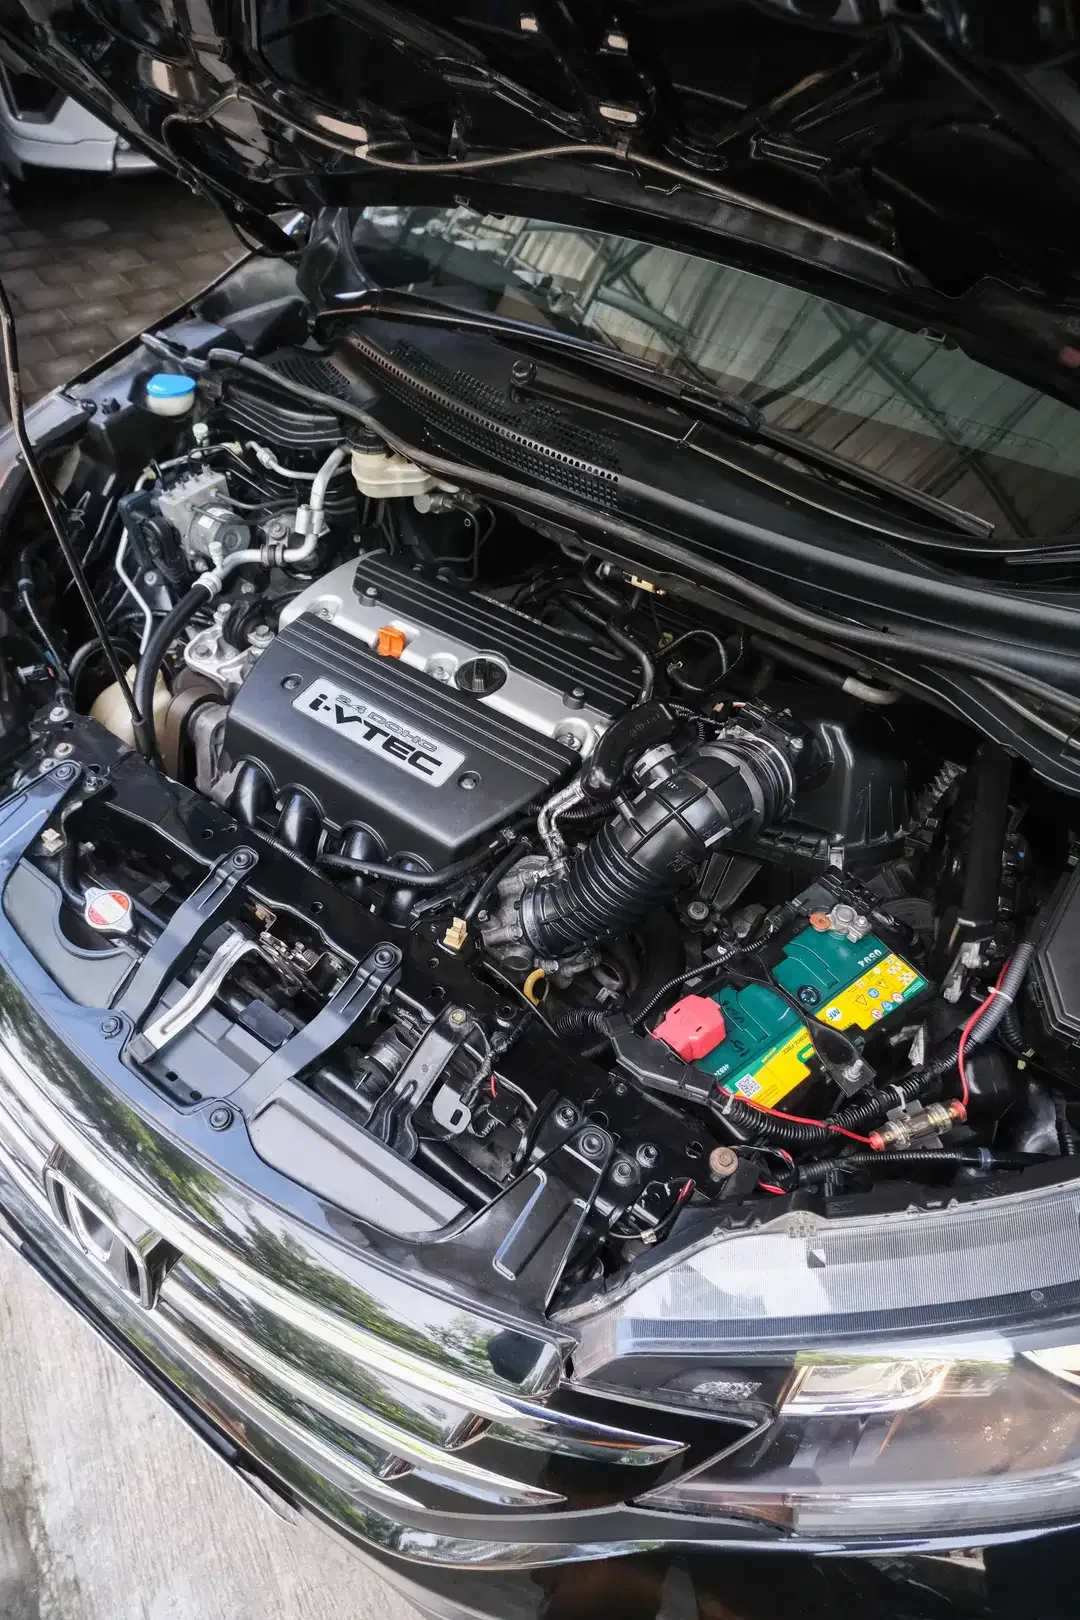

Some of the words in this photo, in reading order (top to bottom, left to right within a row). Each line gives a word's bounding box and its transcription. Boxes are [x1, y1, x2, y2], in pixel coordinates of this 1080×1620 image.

[309, 693, 443, 776] i-VTEC
[335, 694, 367, 714] 2.4
[368, 712, 437, 753] DOHC
[829, 1008, 841, 1021] MF
